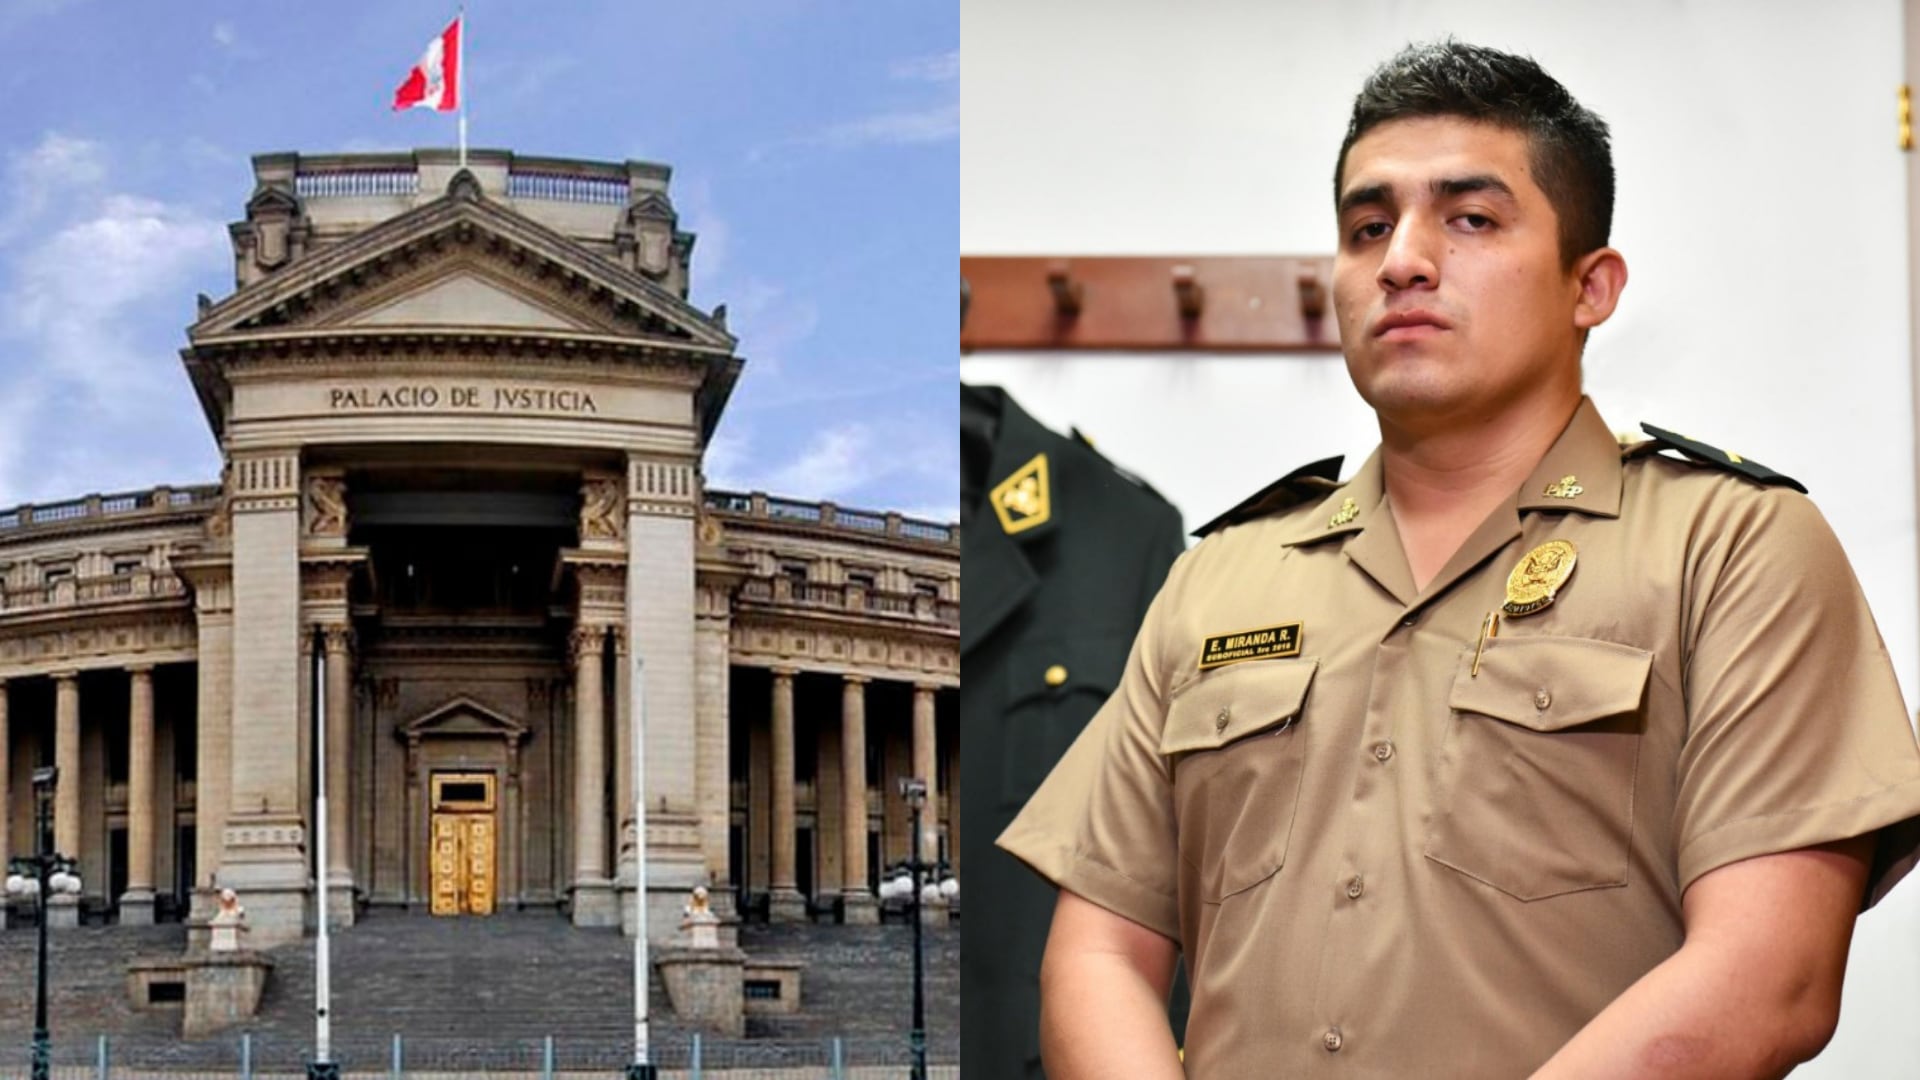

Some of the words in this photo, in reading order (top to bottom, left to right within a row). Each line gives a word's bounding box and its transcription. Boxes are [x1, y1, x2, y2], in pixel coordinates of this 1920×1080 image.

[330, 386, 439, 409] PALACIO
[451, 387, 480, 408] DE
[1210, 640, 1221, 652] E.
[1225, 631, 1276, 650] MIRANDA
[1279, 629, 1291, 641] R.
